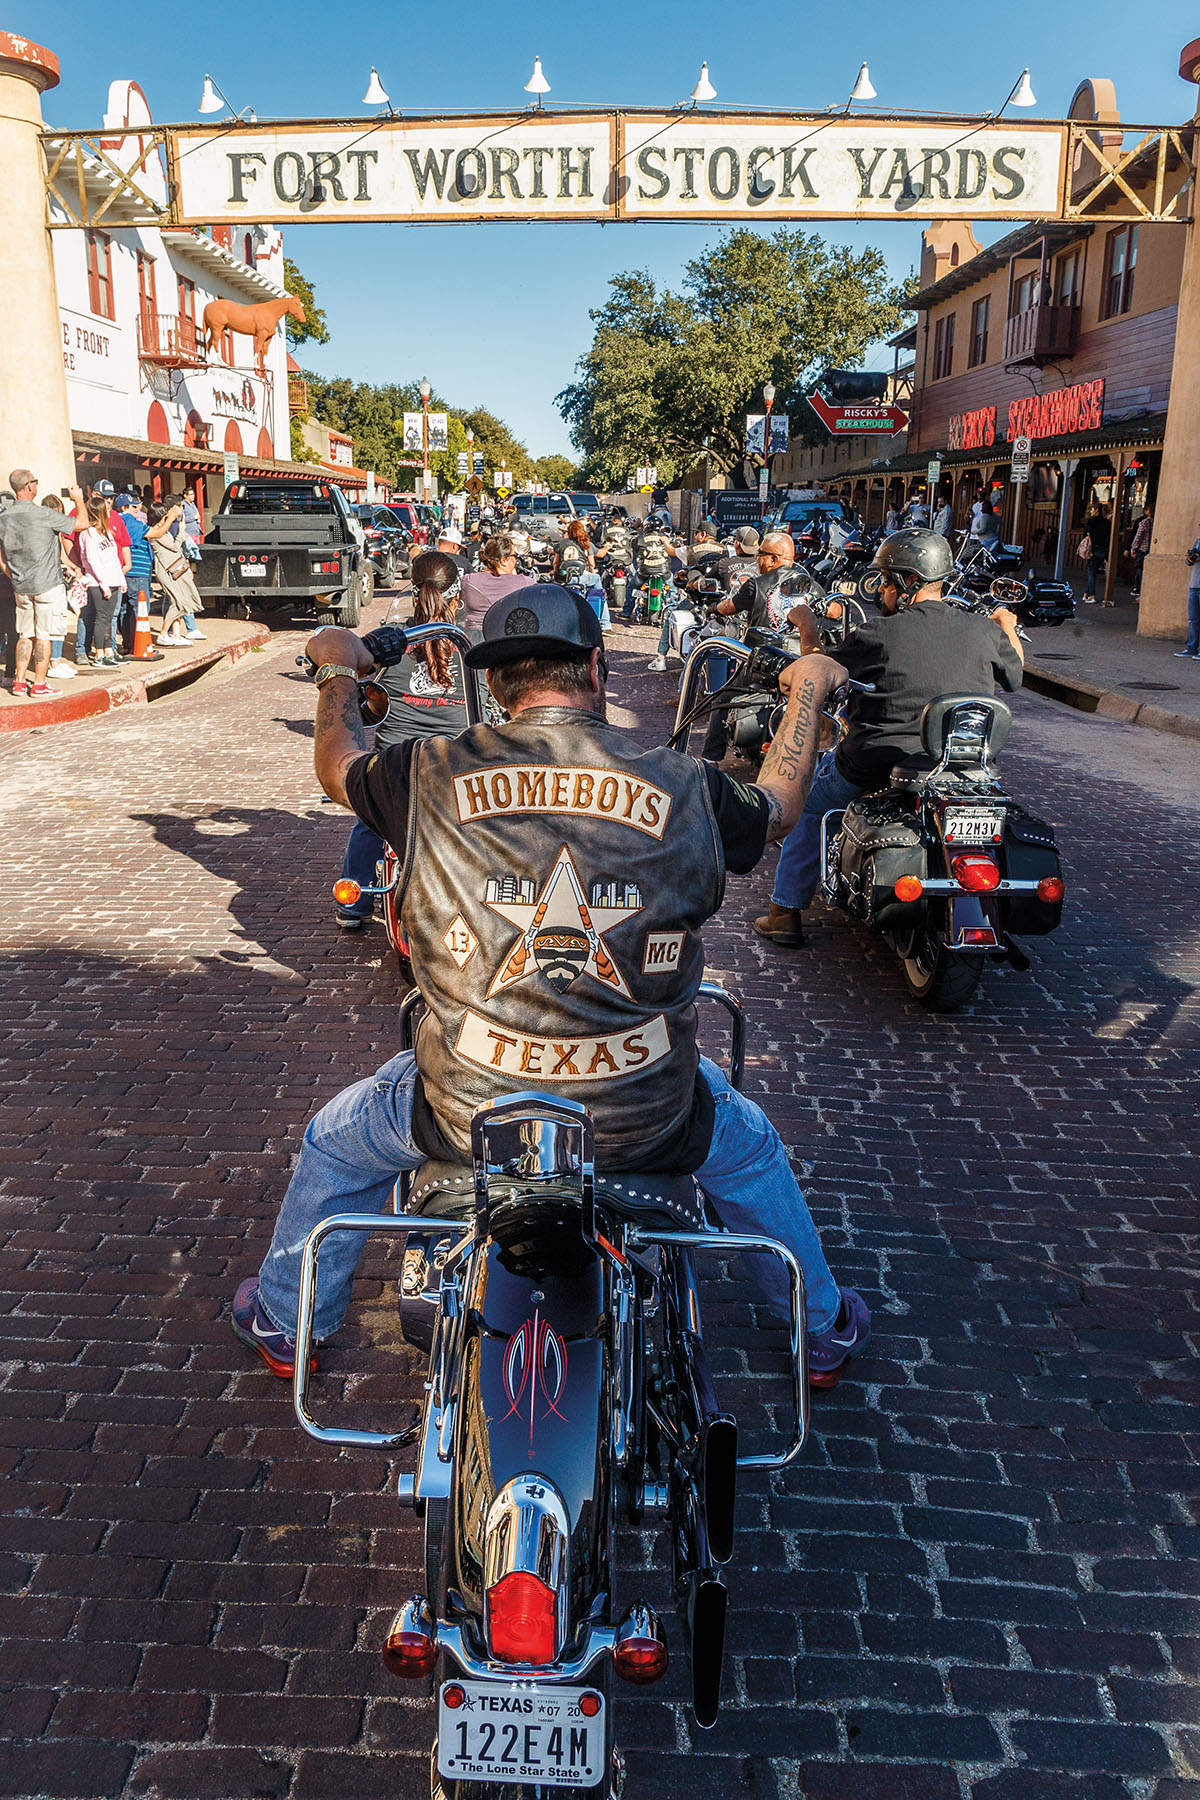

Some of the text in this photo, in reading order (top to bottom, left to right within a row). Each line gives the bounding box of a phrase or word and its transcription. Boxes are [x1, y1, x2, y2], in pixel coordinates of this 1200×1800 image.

[226, 146, 1026, 203] FORT WORTH STOCK YARDS
[76, 327, 110, 357] FRONT
[835, 419, 895, 429] STEAKHOUSE
[844, 408, 888, 417] RISCKY'S
[778, 678, 815, 781] Memphis
[462, 770, 663, 828] HOMEBOYS
[449, 930, 471, 953] 13
[647, 941, 678, 965] MC
[487, 1029, 651, 1075] TEXAS
[478, 1695, 533, 1713] TEXAS
[547, 1706, 560, 1716] 07
[455, 1721, 588, 1767] 122E4M
[461, 1762, 580, 1778] The Lone Star State
